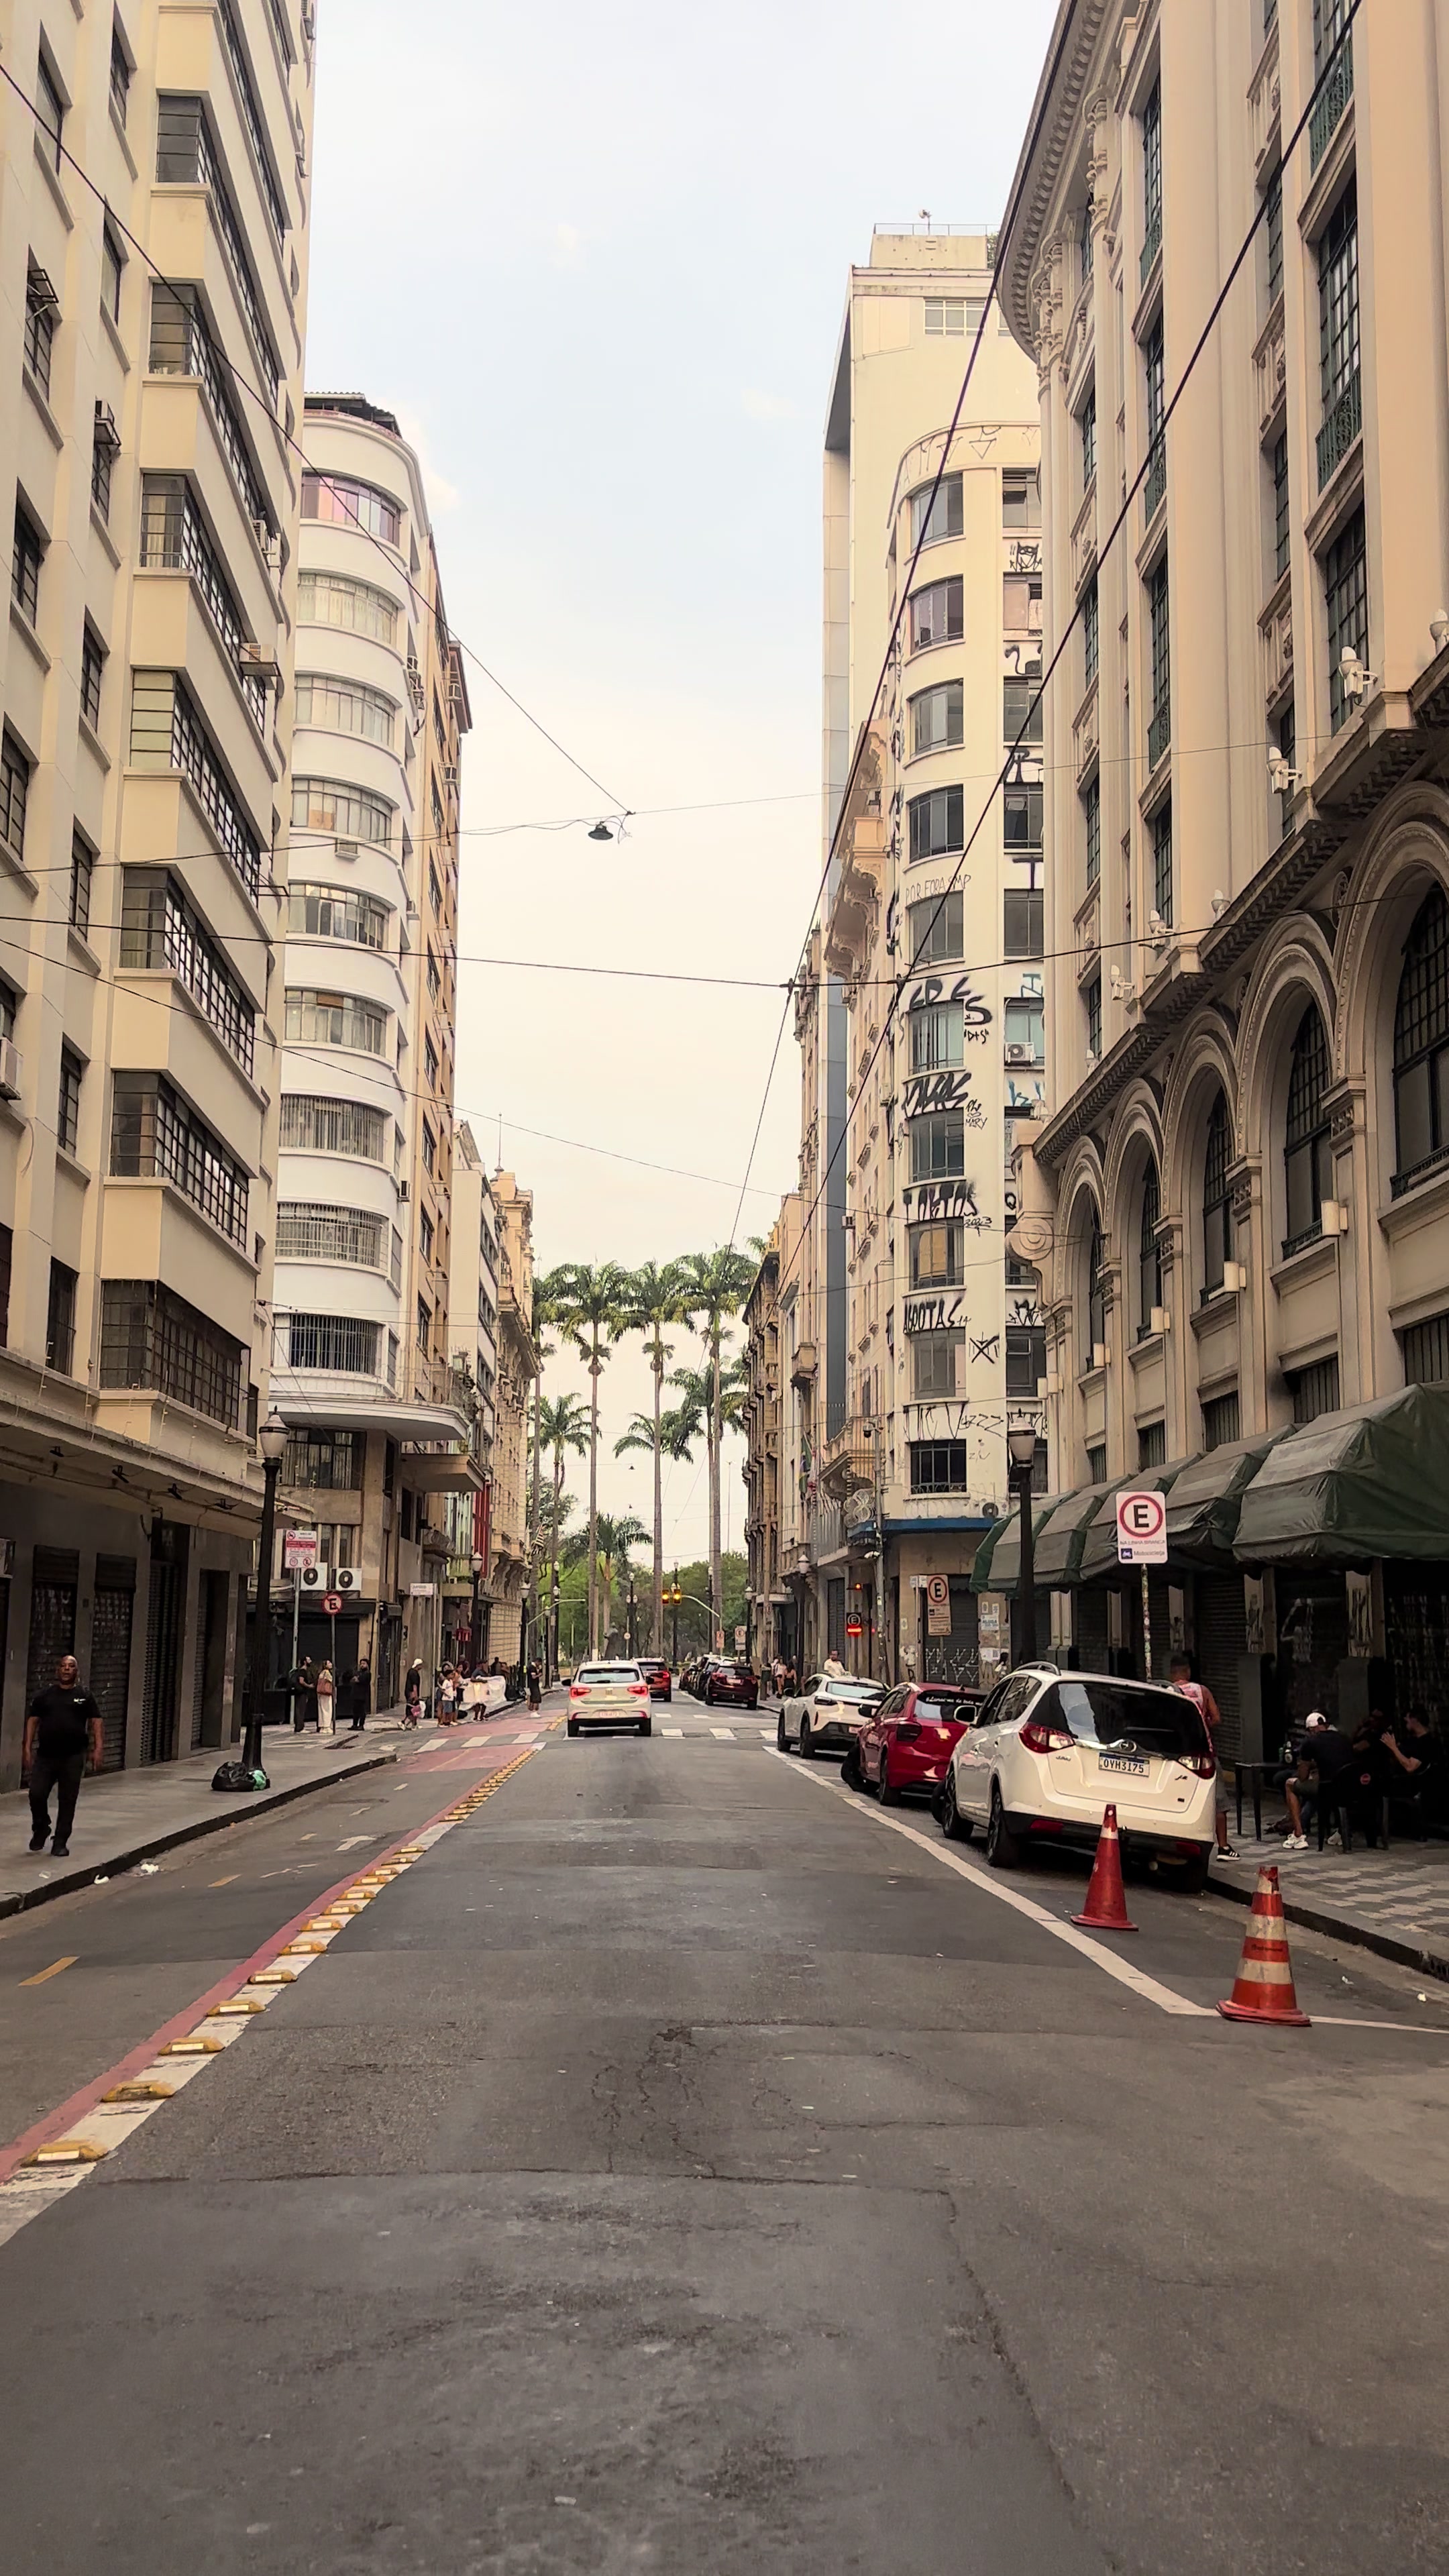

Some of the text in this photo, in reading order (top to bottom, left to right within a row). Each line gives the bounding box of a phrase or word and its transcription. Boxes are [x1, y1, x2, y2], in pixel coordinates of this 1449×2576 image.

[906, 883, 922, 906] POR
[925, 877, 946, 897] FORA
[1133, 1504, 1150, 1528] E
[934, 1582, 942, 1598] E
[329, 1598, 337, 1610] E
[851, 1616, 857, 1624] E
